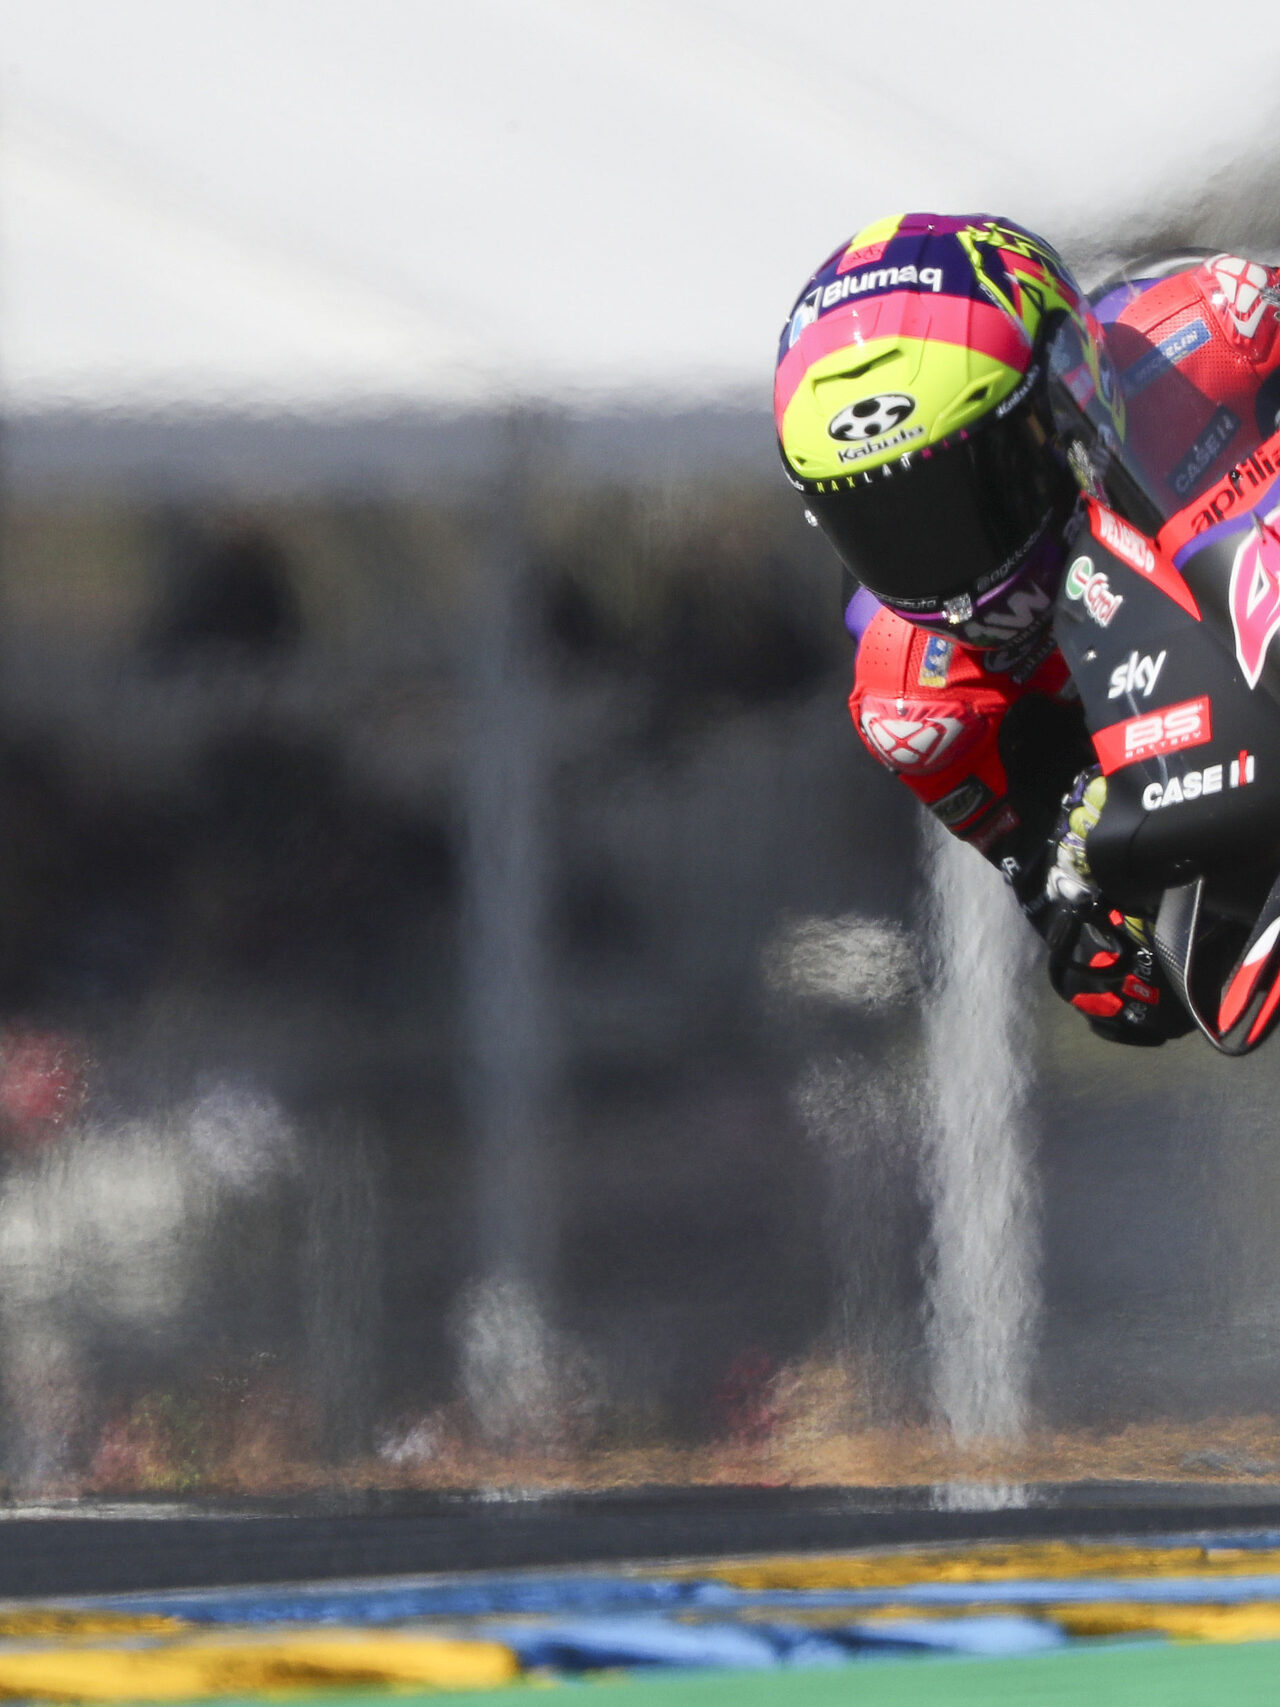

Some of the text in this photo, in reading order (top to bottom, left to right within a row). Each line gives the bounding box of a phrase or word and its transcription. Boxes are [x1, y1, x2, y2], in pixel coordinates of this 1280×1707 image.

[821, 265, 943, 308] Blumaq
[835, 424, 925, 465] Kabuto
[1108, 650, 1167, 699] sky
[1125, 704, 1202, 750] BS
[1142, 764, 1223, 811] CASE
